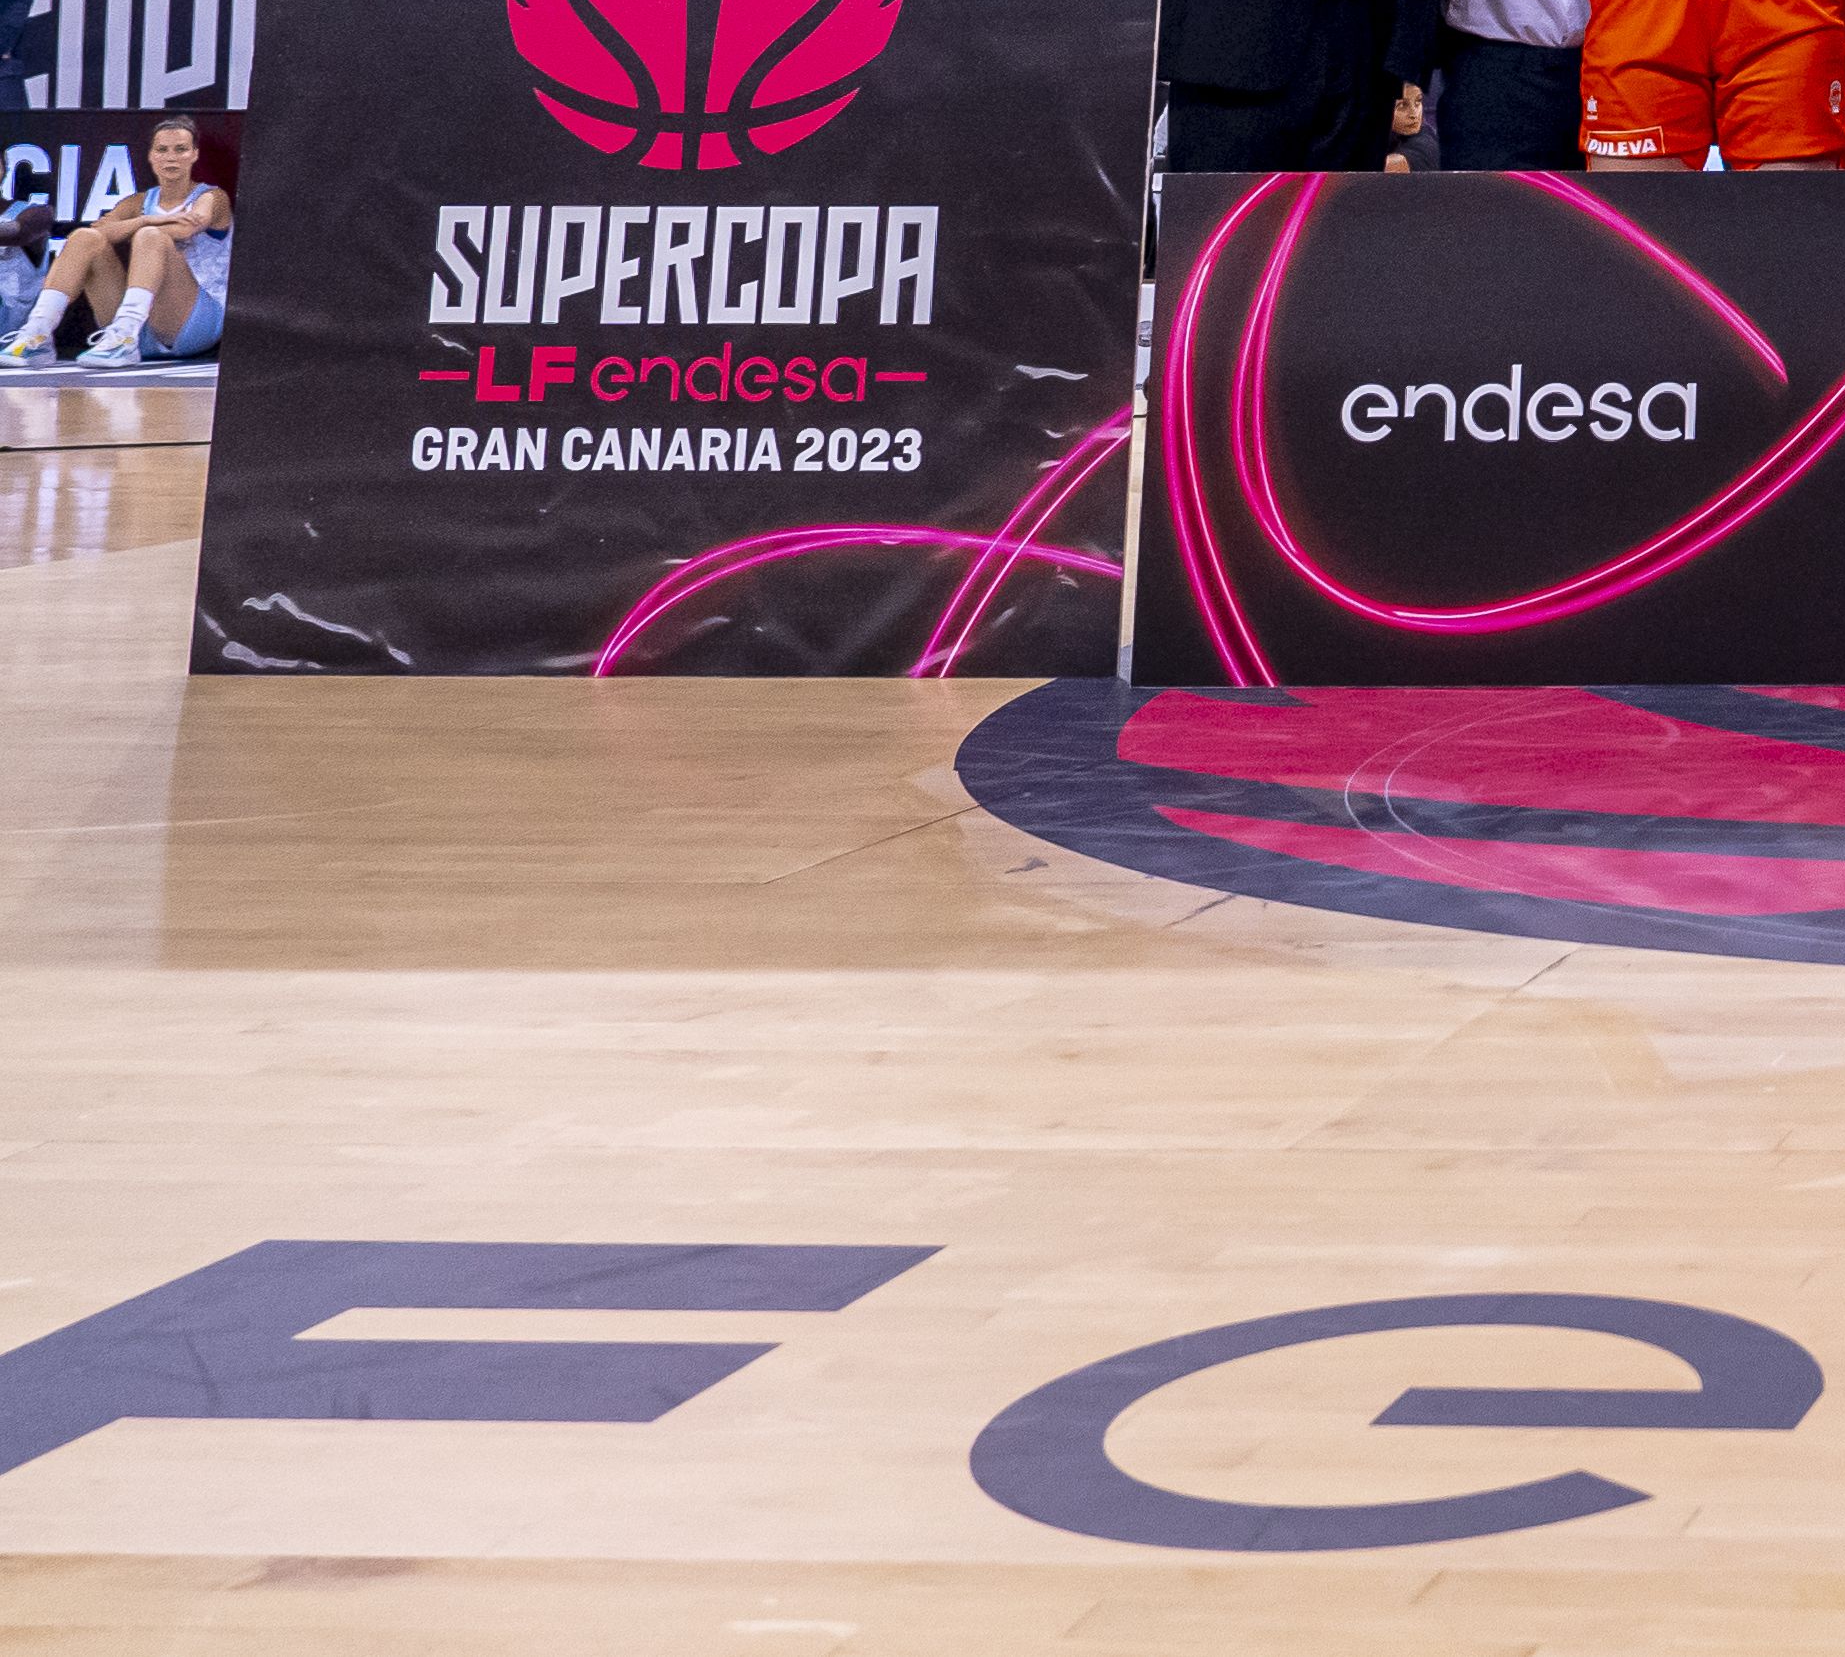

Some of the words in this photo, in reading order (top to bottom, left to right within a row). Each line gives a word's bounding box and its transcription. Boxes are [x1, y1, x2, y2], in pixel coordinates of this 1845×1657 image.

[428, 205, 940, 325] SUPERCOPA
[475, 345, 578, 402] LF
[590, 341, 869, 403] endesa
[1341, 364, 1698, 443] endesa
[412, 427, 548, 471] GRAN
[562, 427, 782, 471] CANARIA
[794, 427, 924, 472] 2023
